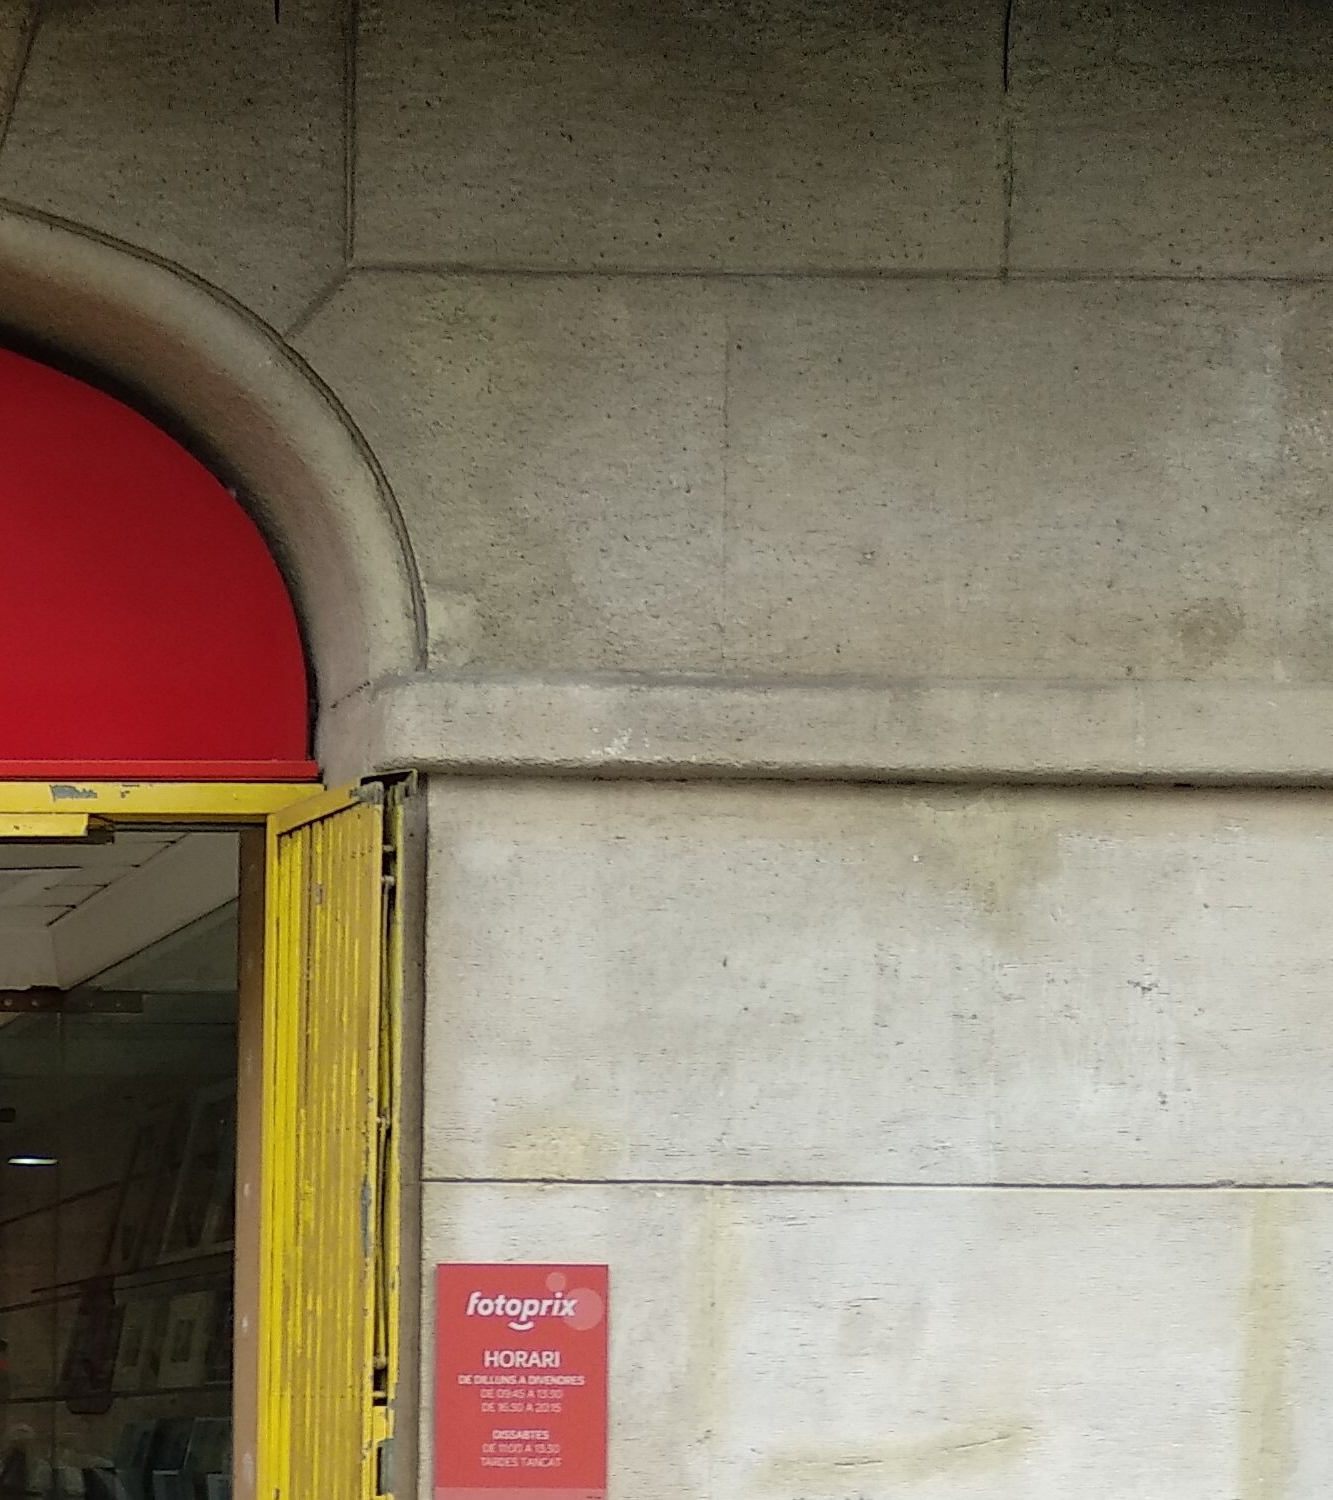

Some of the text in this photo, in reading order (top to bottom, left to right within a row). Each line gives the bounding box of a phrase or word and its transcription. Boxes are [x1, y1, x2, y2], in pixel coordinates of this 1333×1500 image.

[466, 1291, 578, 1321] fotoprix
[484, 1350, 561, 1368] HORARI
[458, 1375, 585, 1386] DE DILLUNS A DIVENDRES
